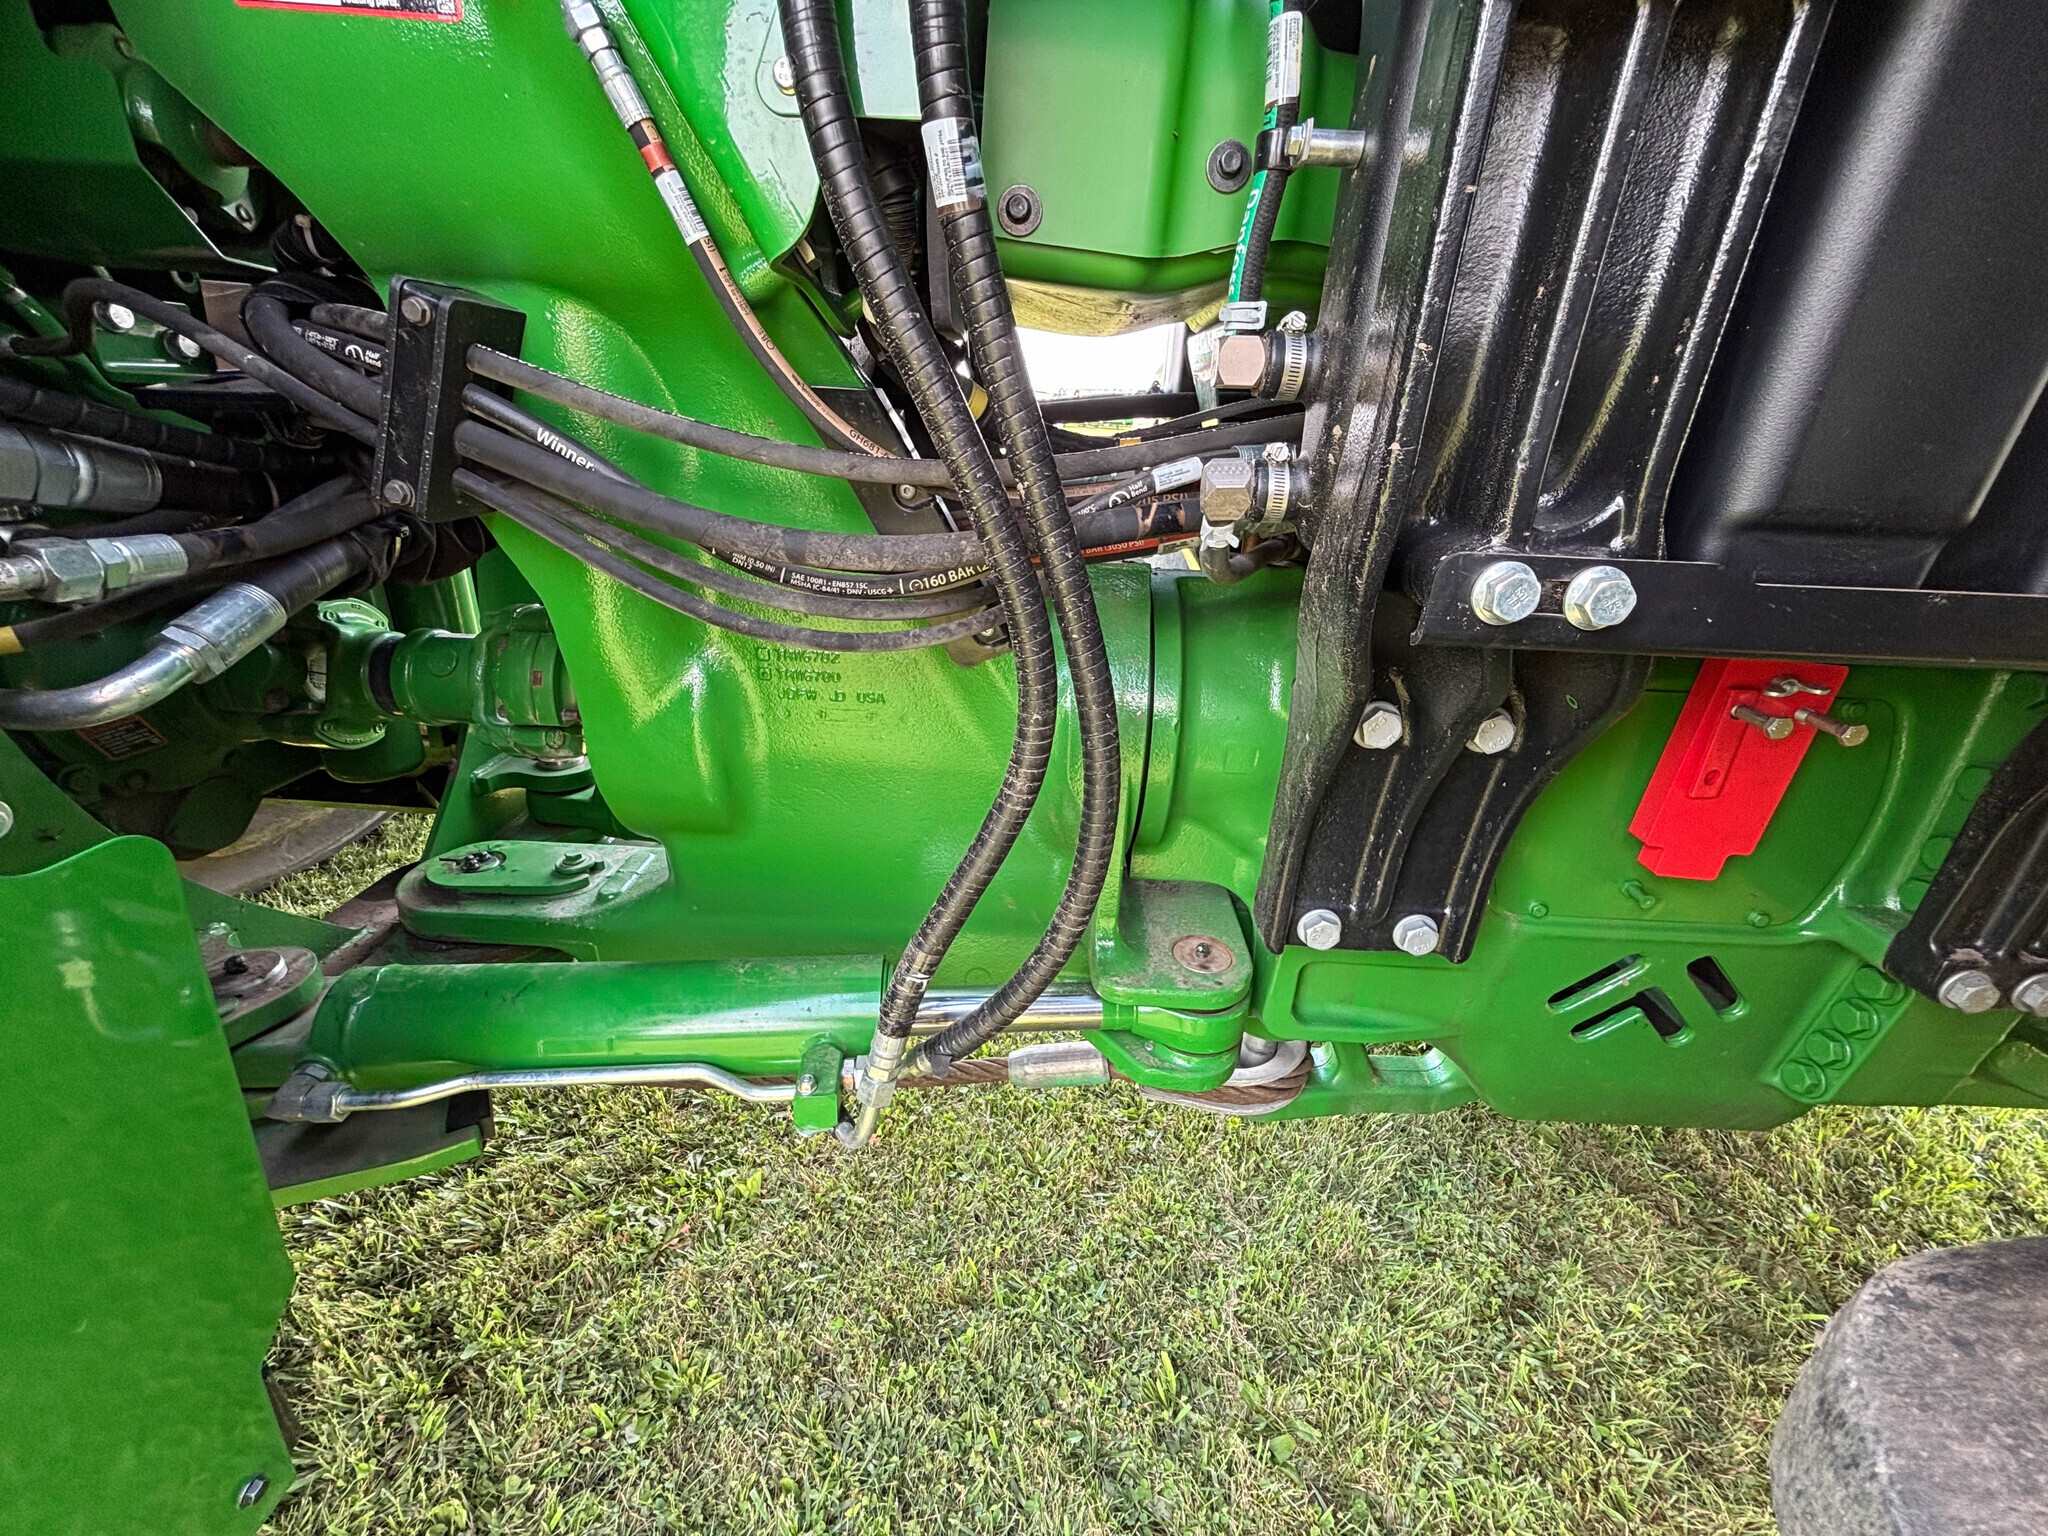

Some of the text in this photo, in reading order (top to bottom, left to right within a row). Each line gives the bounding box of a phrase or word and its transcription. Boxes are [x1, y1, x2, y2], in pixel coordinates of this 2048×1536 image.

[365, 355, 382, 368] Bend
[366, 350, 380, 360] Half
[1128, 480, 1144, 492] Half
[1130, 485, 1148, 498] Bend
[765, 564, 776, 573] IN)
[790, 578, 812, 590] MSHA
[791, 571, 805, 581] SAE
[807, 575, 827, 586] 100R1
[832, 580, 854, 589] EN857
[923, 574, 946, 589] 160
[856, 691, 886, 705] USA
